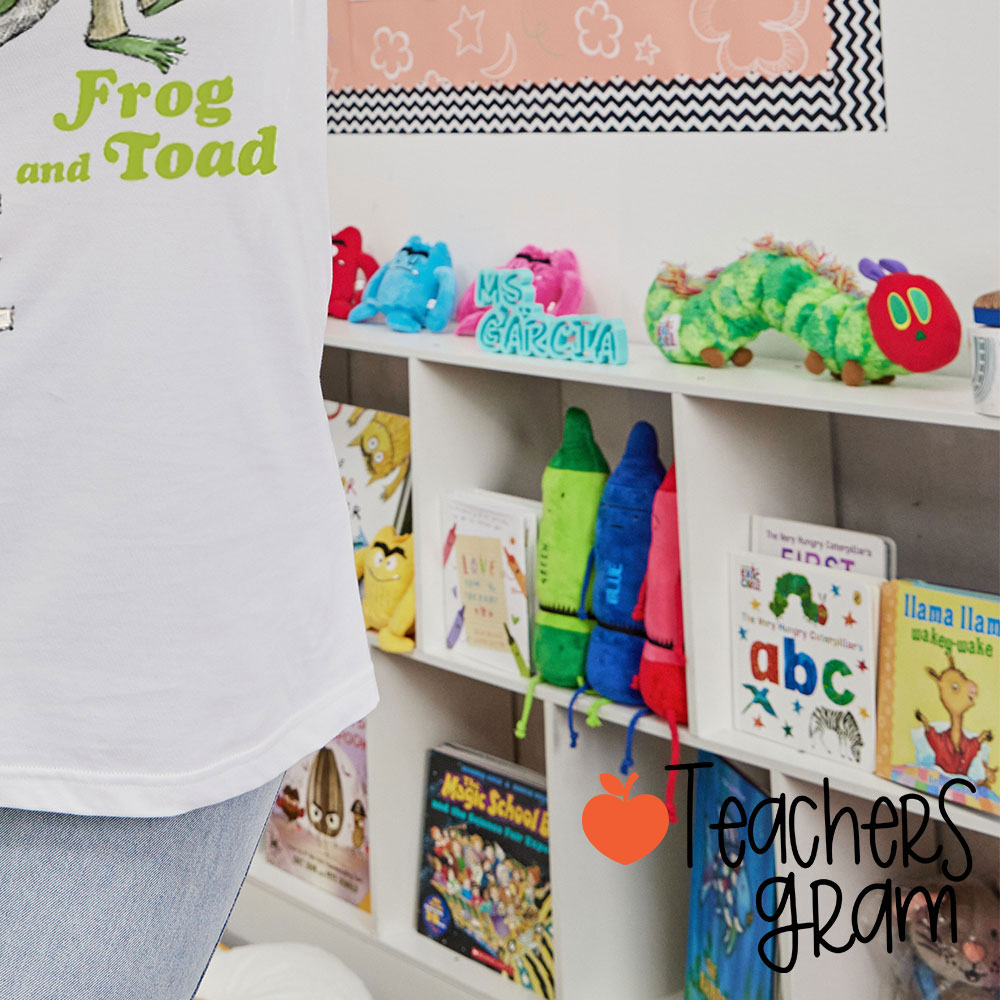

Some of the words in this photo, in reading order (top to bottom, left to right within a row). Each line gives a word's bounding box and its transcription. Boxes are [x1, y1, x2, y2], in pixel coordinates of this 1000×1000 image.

[52, 68, 235, 132] Frog
[15, 152, 91, 185] and
[103, 125, 278, 181] Toad
[476, 270, 524, 306] MS
[478, 307, 622, 366] GARCIA
[765, 529, 778, 540] The
[904, 593, 954, 627] llama
[961, 604, 1000, 638] llam
[749, 636, 856, 707] abc
[440, 772, 488, 811] Magic
[486, 788, 541, 833] School
